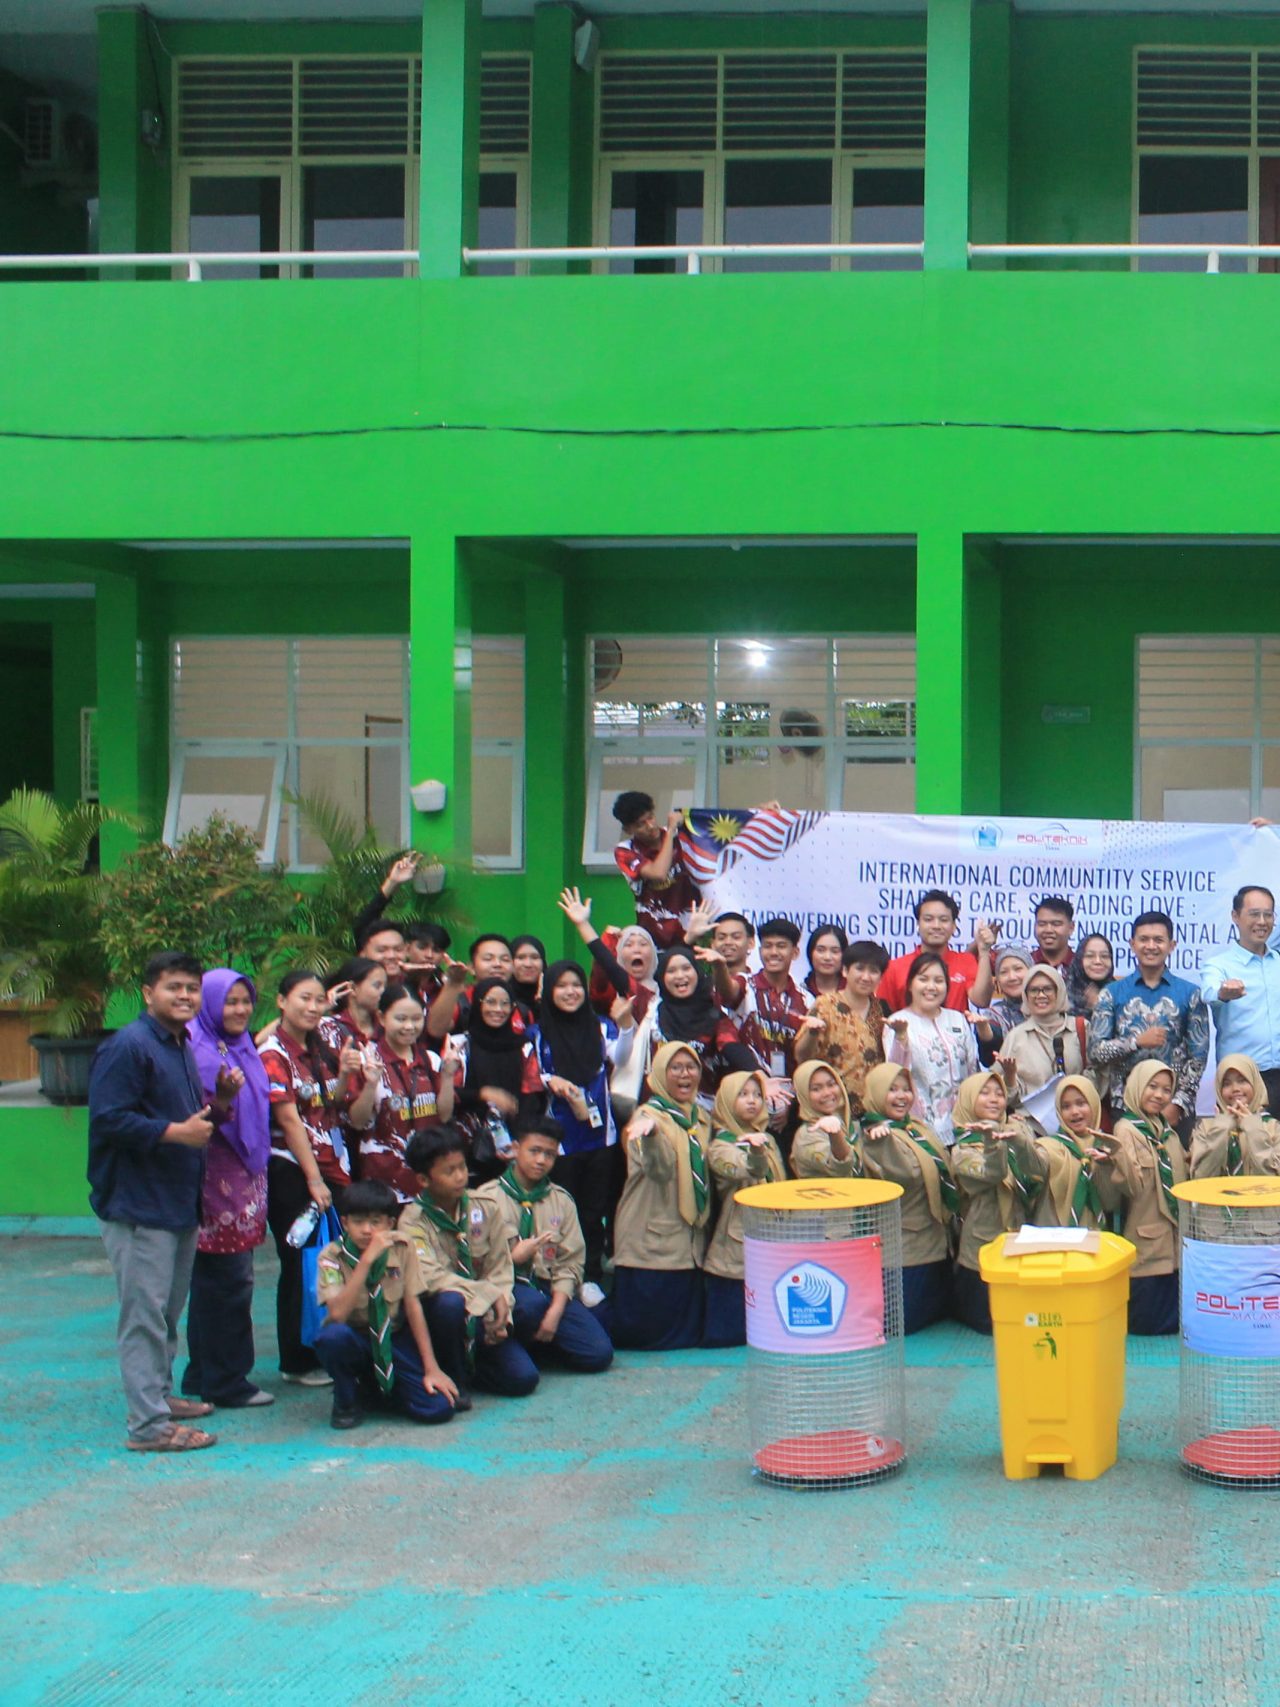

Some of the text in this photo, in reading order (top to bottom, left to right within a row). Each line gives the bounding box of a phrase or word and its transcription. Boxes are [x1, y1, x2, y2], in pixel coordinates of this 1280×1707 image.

[859, 861, 1216, 893] INTERNATIONAL COMMUNTITY SERVICE
[879, 887, 962, 912] SHAG
[969, 890, 1021, 914] CARE,
[1029, 891, 1133, 917] SADING
[867, 914, 961, 939] STUDS
[1069, 918, 1220, 945] NVIRONTAL
[882, 941, 906, 959] ND
